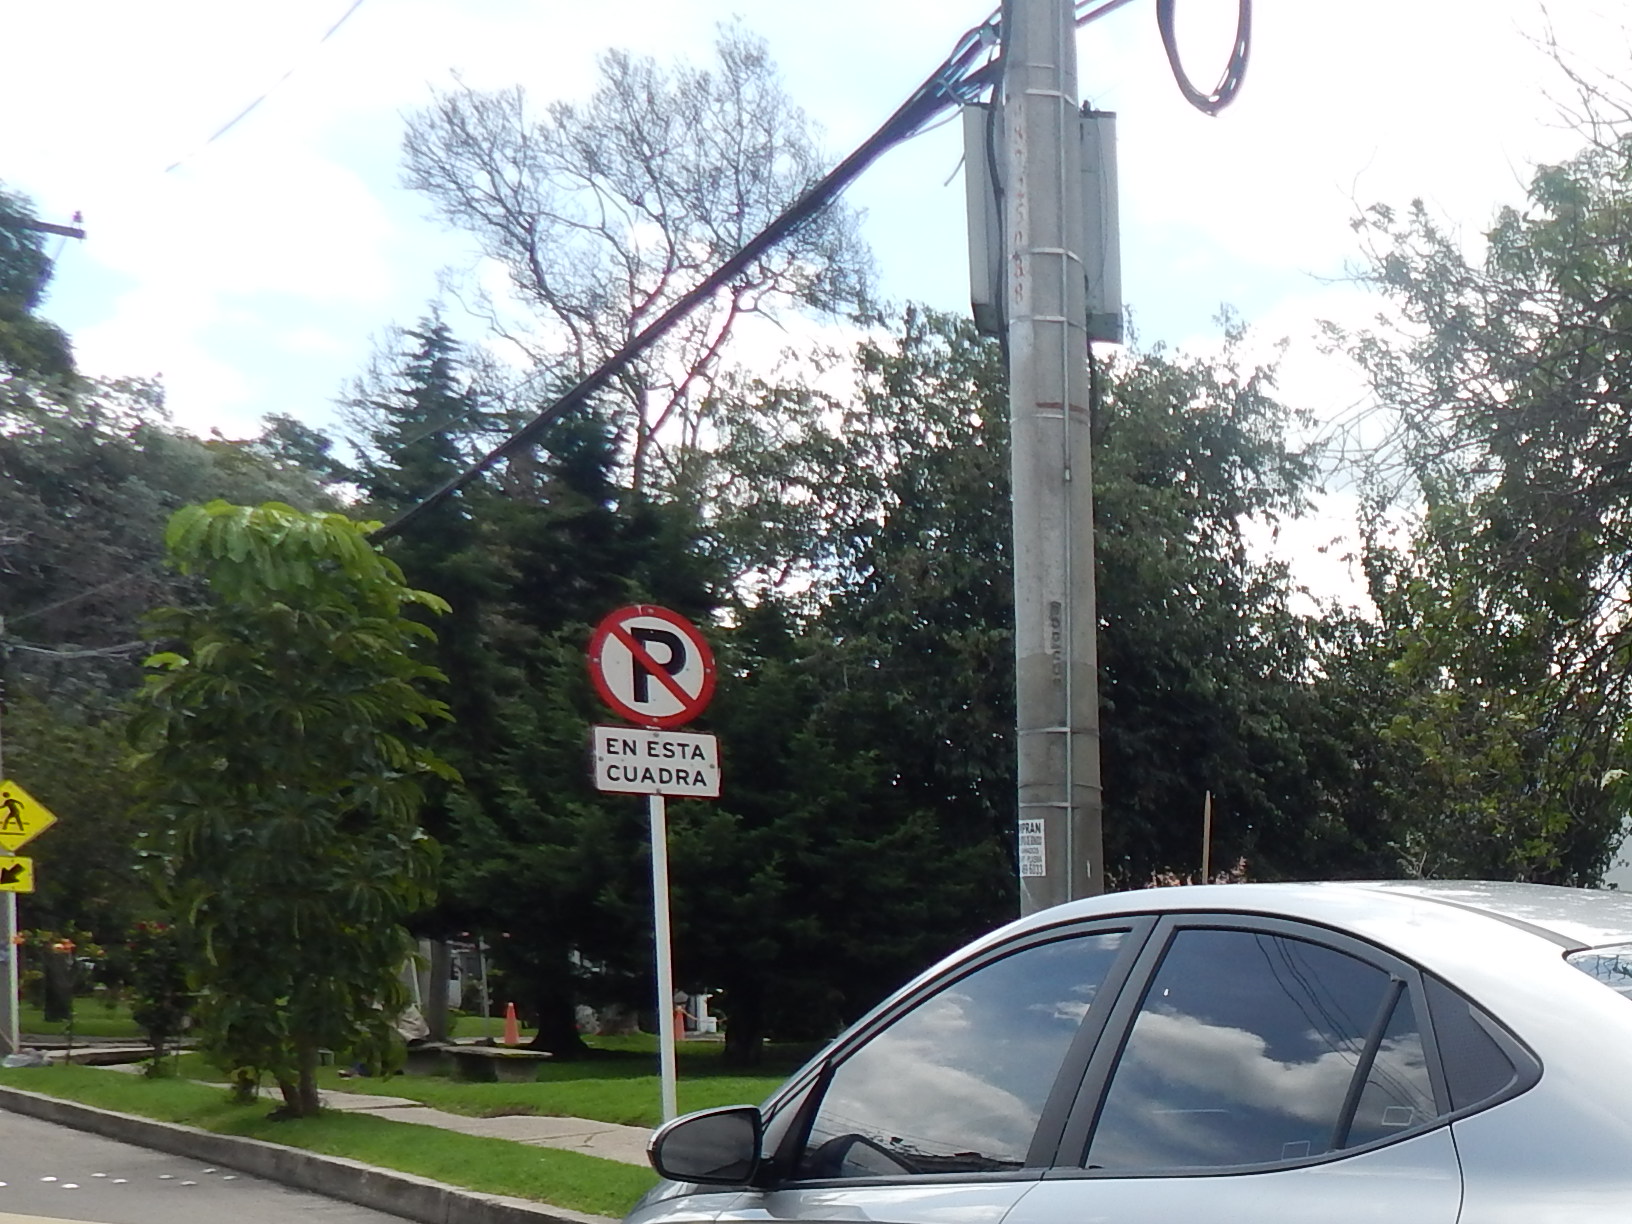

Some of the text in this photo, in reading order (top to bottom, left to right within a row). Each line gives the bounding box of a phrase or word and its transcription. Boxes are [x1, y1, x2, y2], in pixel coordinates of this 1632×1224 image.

[606, 737, 706, 761] EN ESTA
[606, 764, 707, 787] CUADRA
